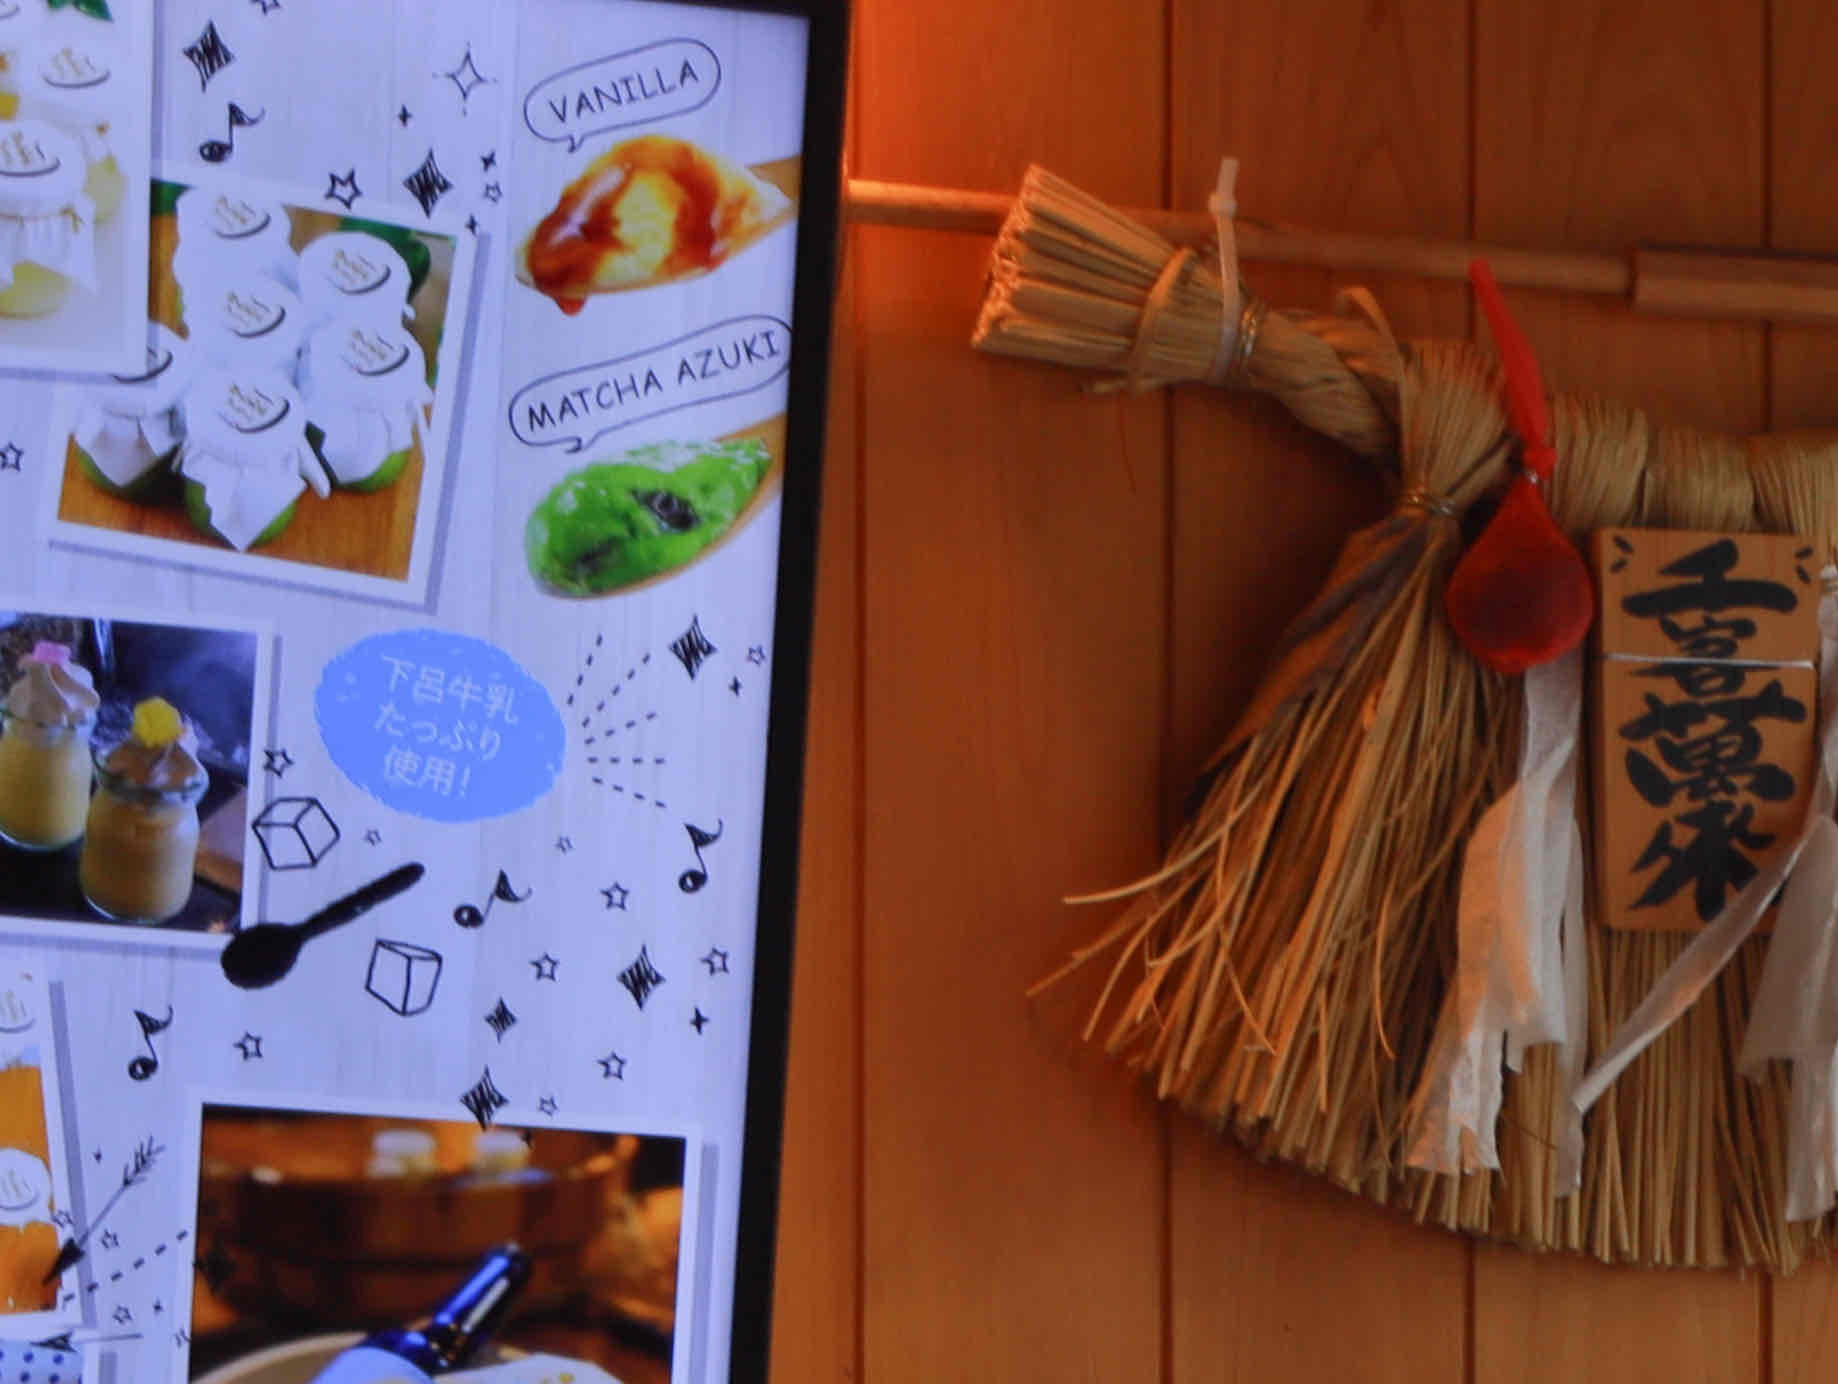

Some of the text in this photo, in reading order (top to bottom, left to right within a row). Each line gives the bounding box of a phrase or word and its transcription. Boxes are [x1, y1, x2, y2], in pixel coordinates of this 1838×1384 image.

[548, 59, 699, 124] VANILLA
[528, 330, 781, 432] MATCHA AZUKI
[382, 654, 519, 724] 下呂牛乳
